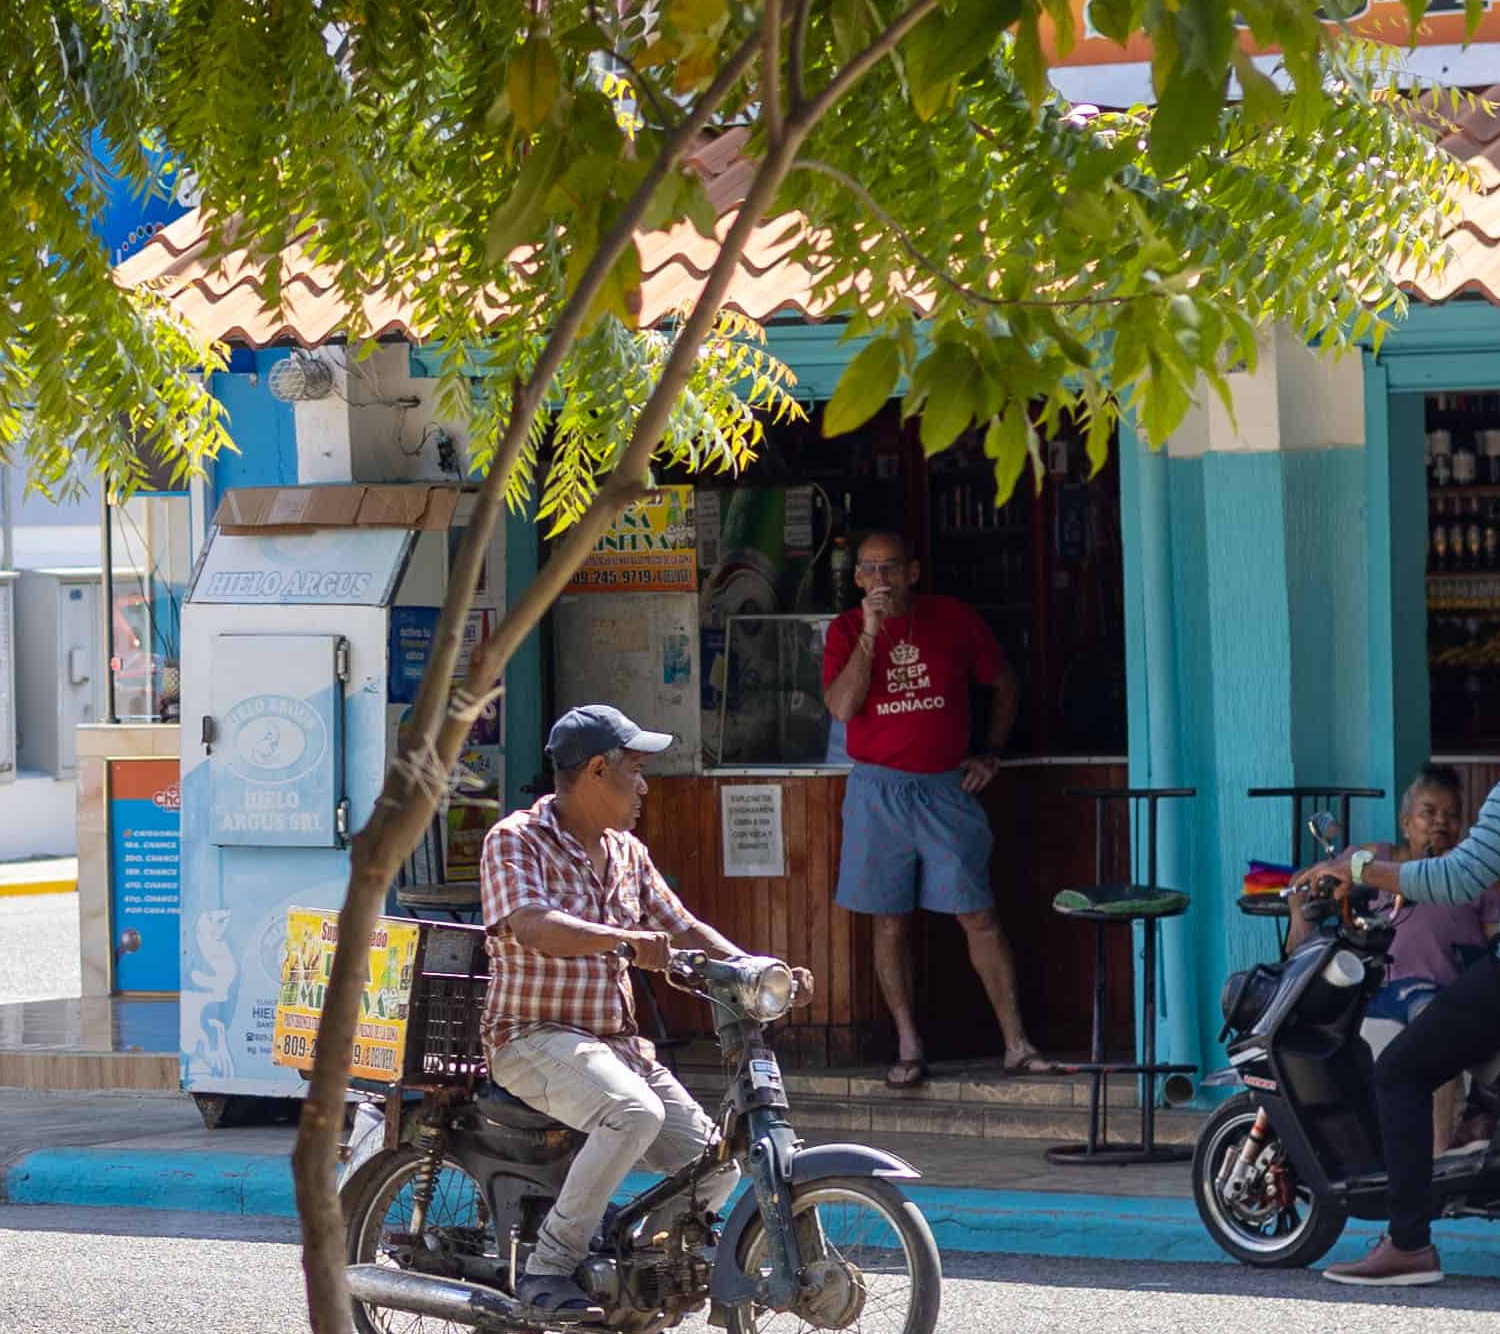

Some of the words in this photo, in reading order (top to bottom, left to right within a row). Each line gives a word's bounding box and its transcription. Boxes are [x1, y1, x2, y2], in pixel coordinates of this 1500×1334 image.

[207, 570, 281, 597] HIELO
[280, 570, 373, 598] ARGUS
[888, 676, 930, 693] CALM
[876, 696, 944, 715] MONACO
[252, 1008, 276, 1019] HIEL
